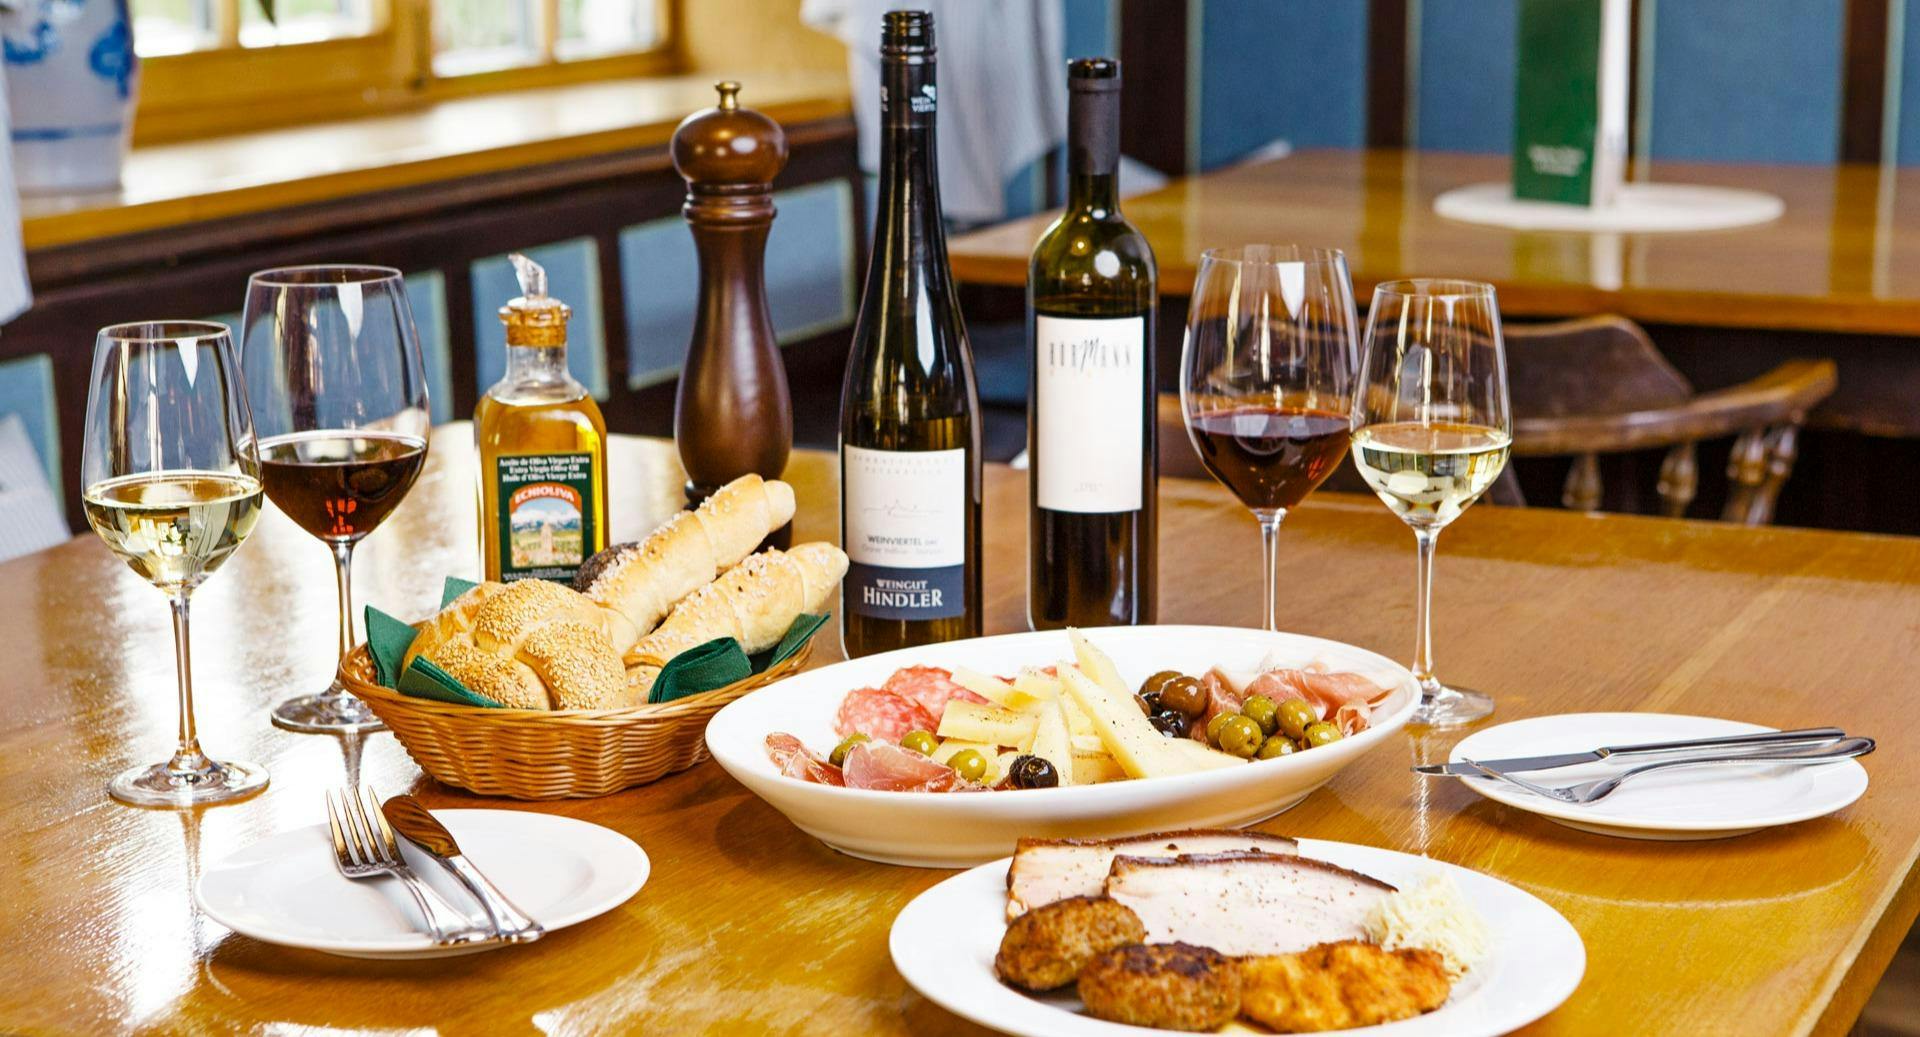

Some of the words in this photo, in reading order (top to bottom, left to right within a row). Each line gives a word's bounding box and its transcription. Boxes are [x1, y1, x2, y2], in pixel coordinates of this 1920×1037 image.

[499, 458, 519, 467] Aceite
[520, 458, 528, 466] de
[547, 456, 570, 466] Virgen
[570, 456, 590, 464] Extra
[509, 466, 528, 474] Extra
[528, 465, 549, 473] Virgin
[502, 474, 520, 482] Huile
[546, 473, 567, 482] Vierge
[568, 472, 587, 480] Extra
[867, 535, 922, 546] WEINVIERTEL
[876, 579, 928, 589] WEINGUT
[863, 586, 944, 608] HINDLER
